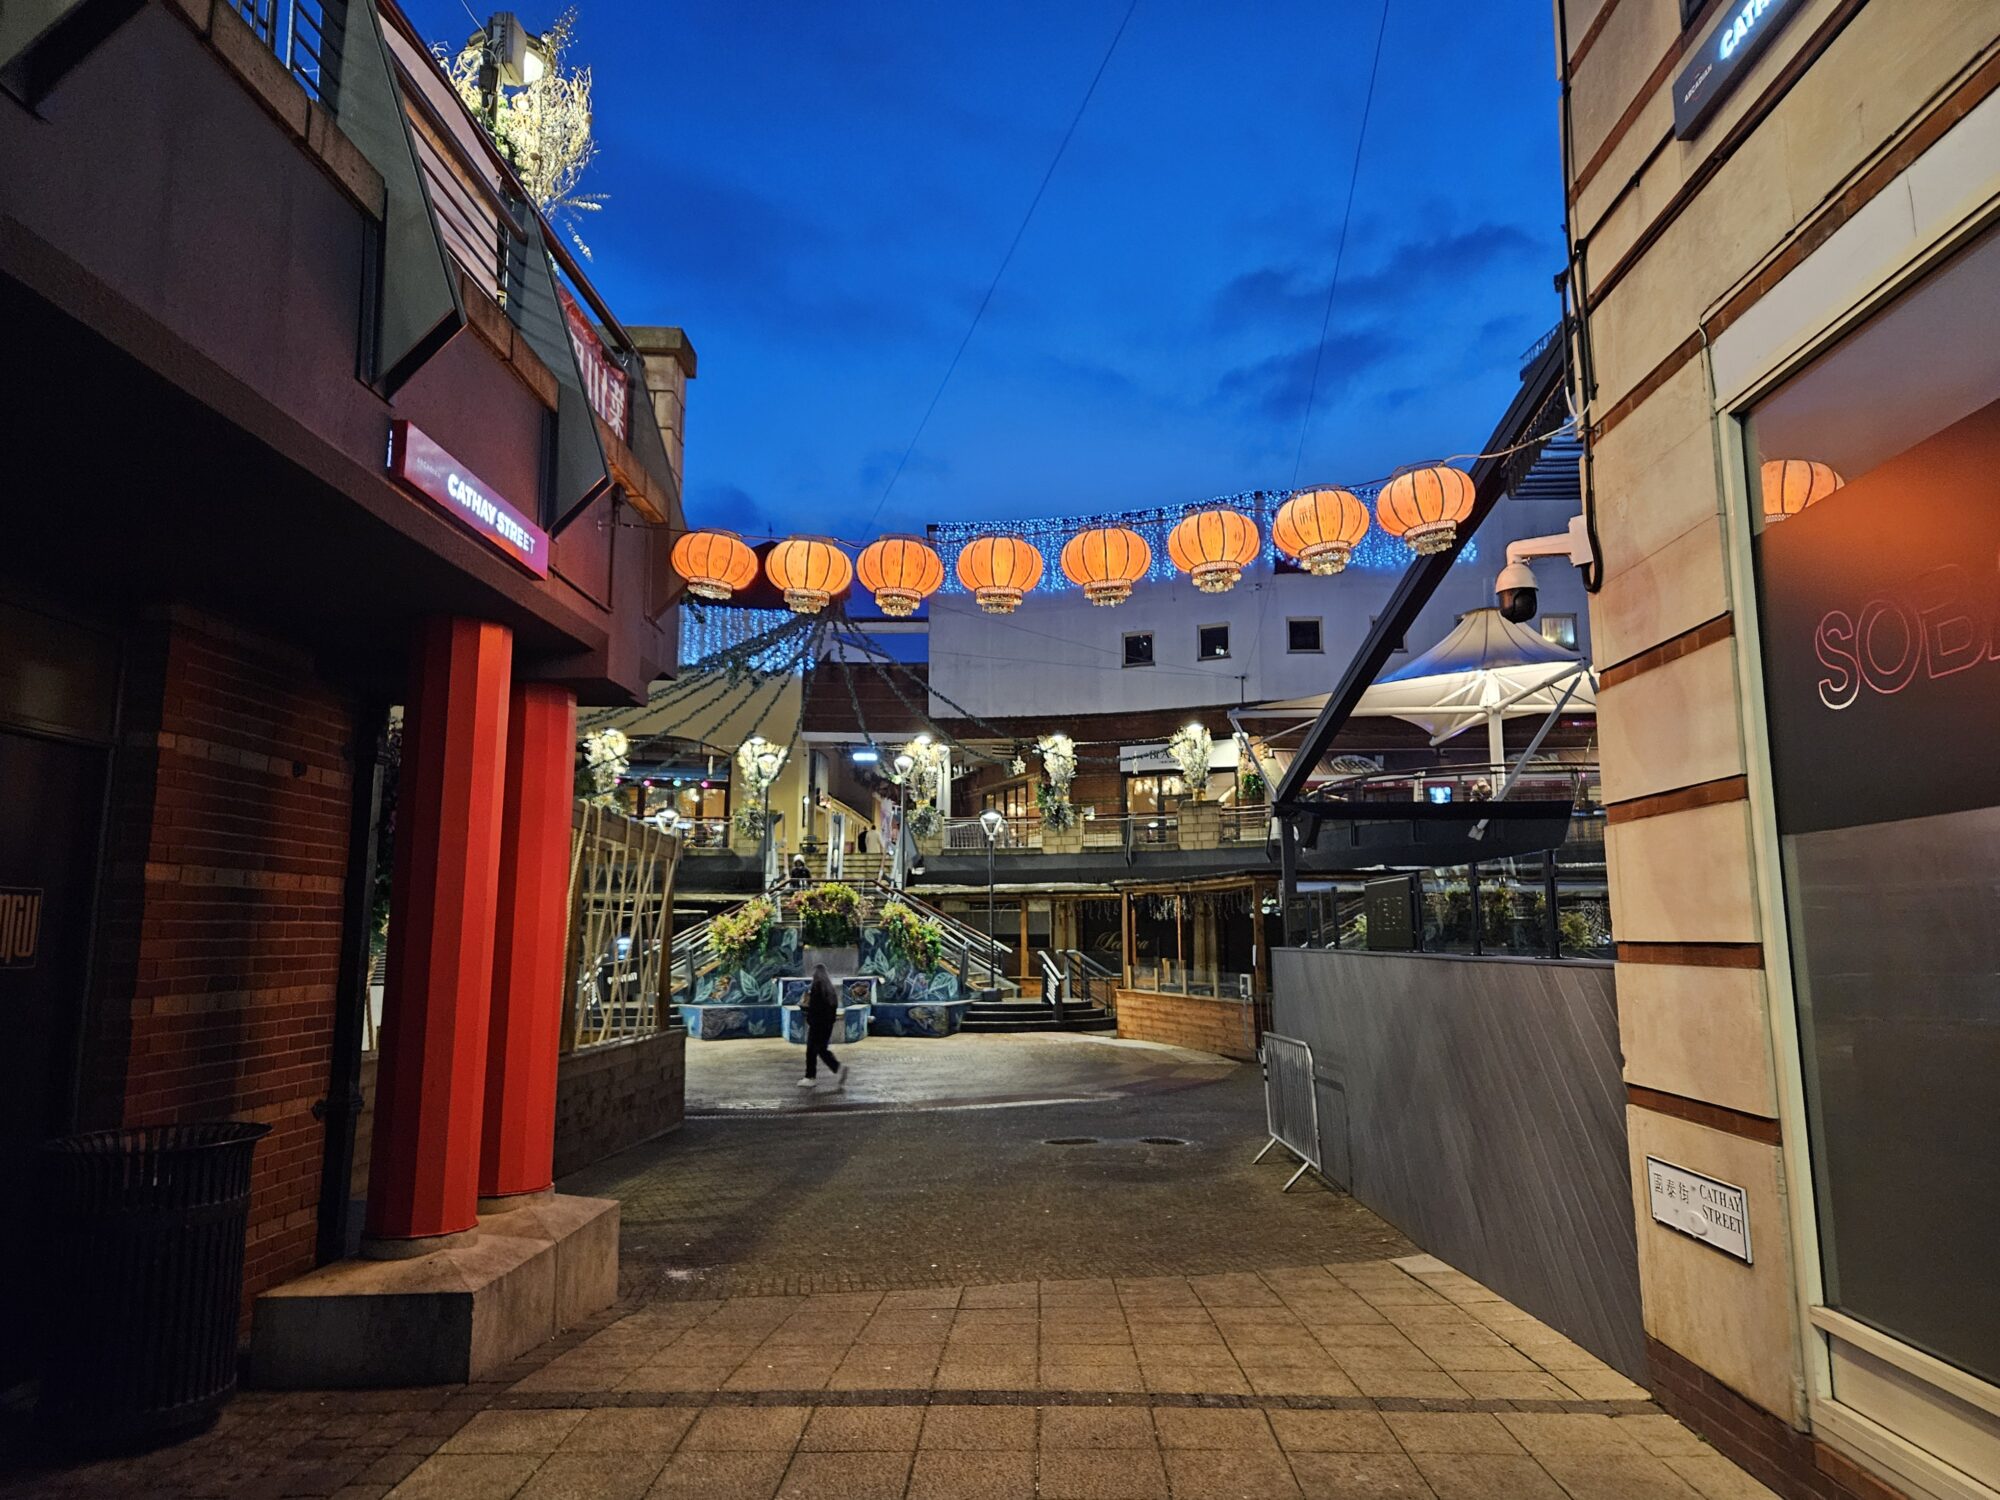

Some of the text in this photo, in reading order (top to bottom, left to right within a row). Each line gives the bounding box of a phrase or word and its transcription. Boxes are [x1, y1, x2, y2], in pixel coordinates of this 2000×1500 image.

[448, 473, 536, 554] CATHAY STREET
[1699, 1183, 1741, 1213] CATHAY
[1702, 1204, 1743, 1235] STREET
